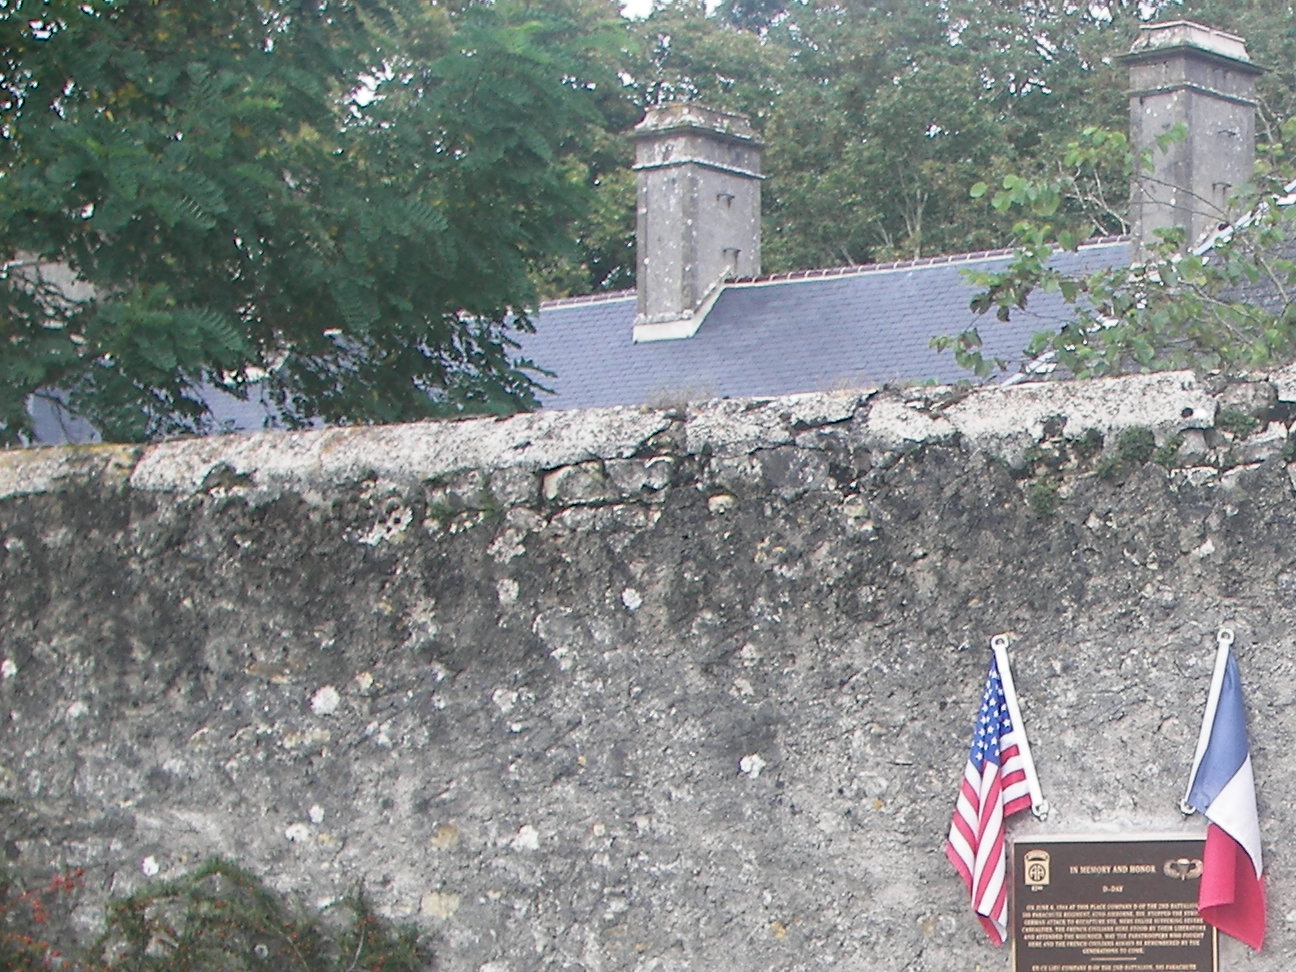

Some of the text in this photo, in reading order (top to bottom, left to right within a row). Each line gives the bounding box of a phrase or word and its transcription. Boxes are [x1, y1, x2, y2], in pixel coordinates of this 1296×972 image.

[1070, 865, 1157, 874] IN MEMORY AND HONOR
